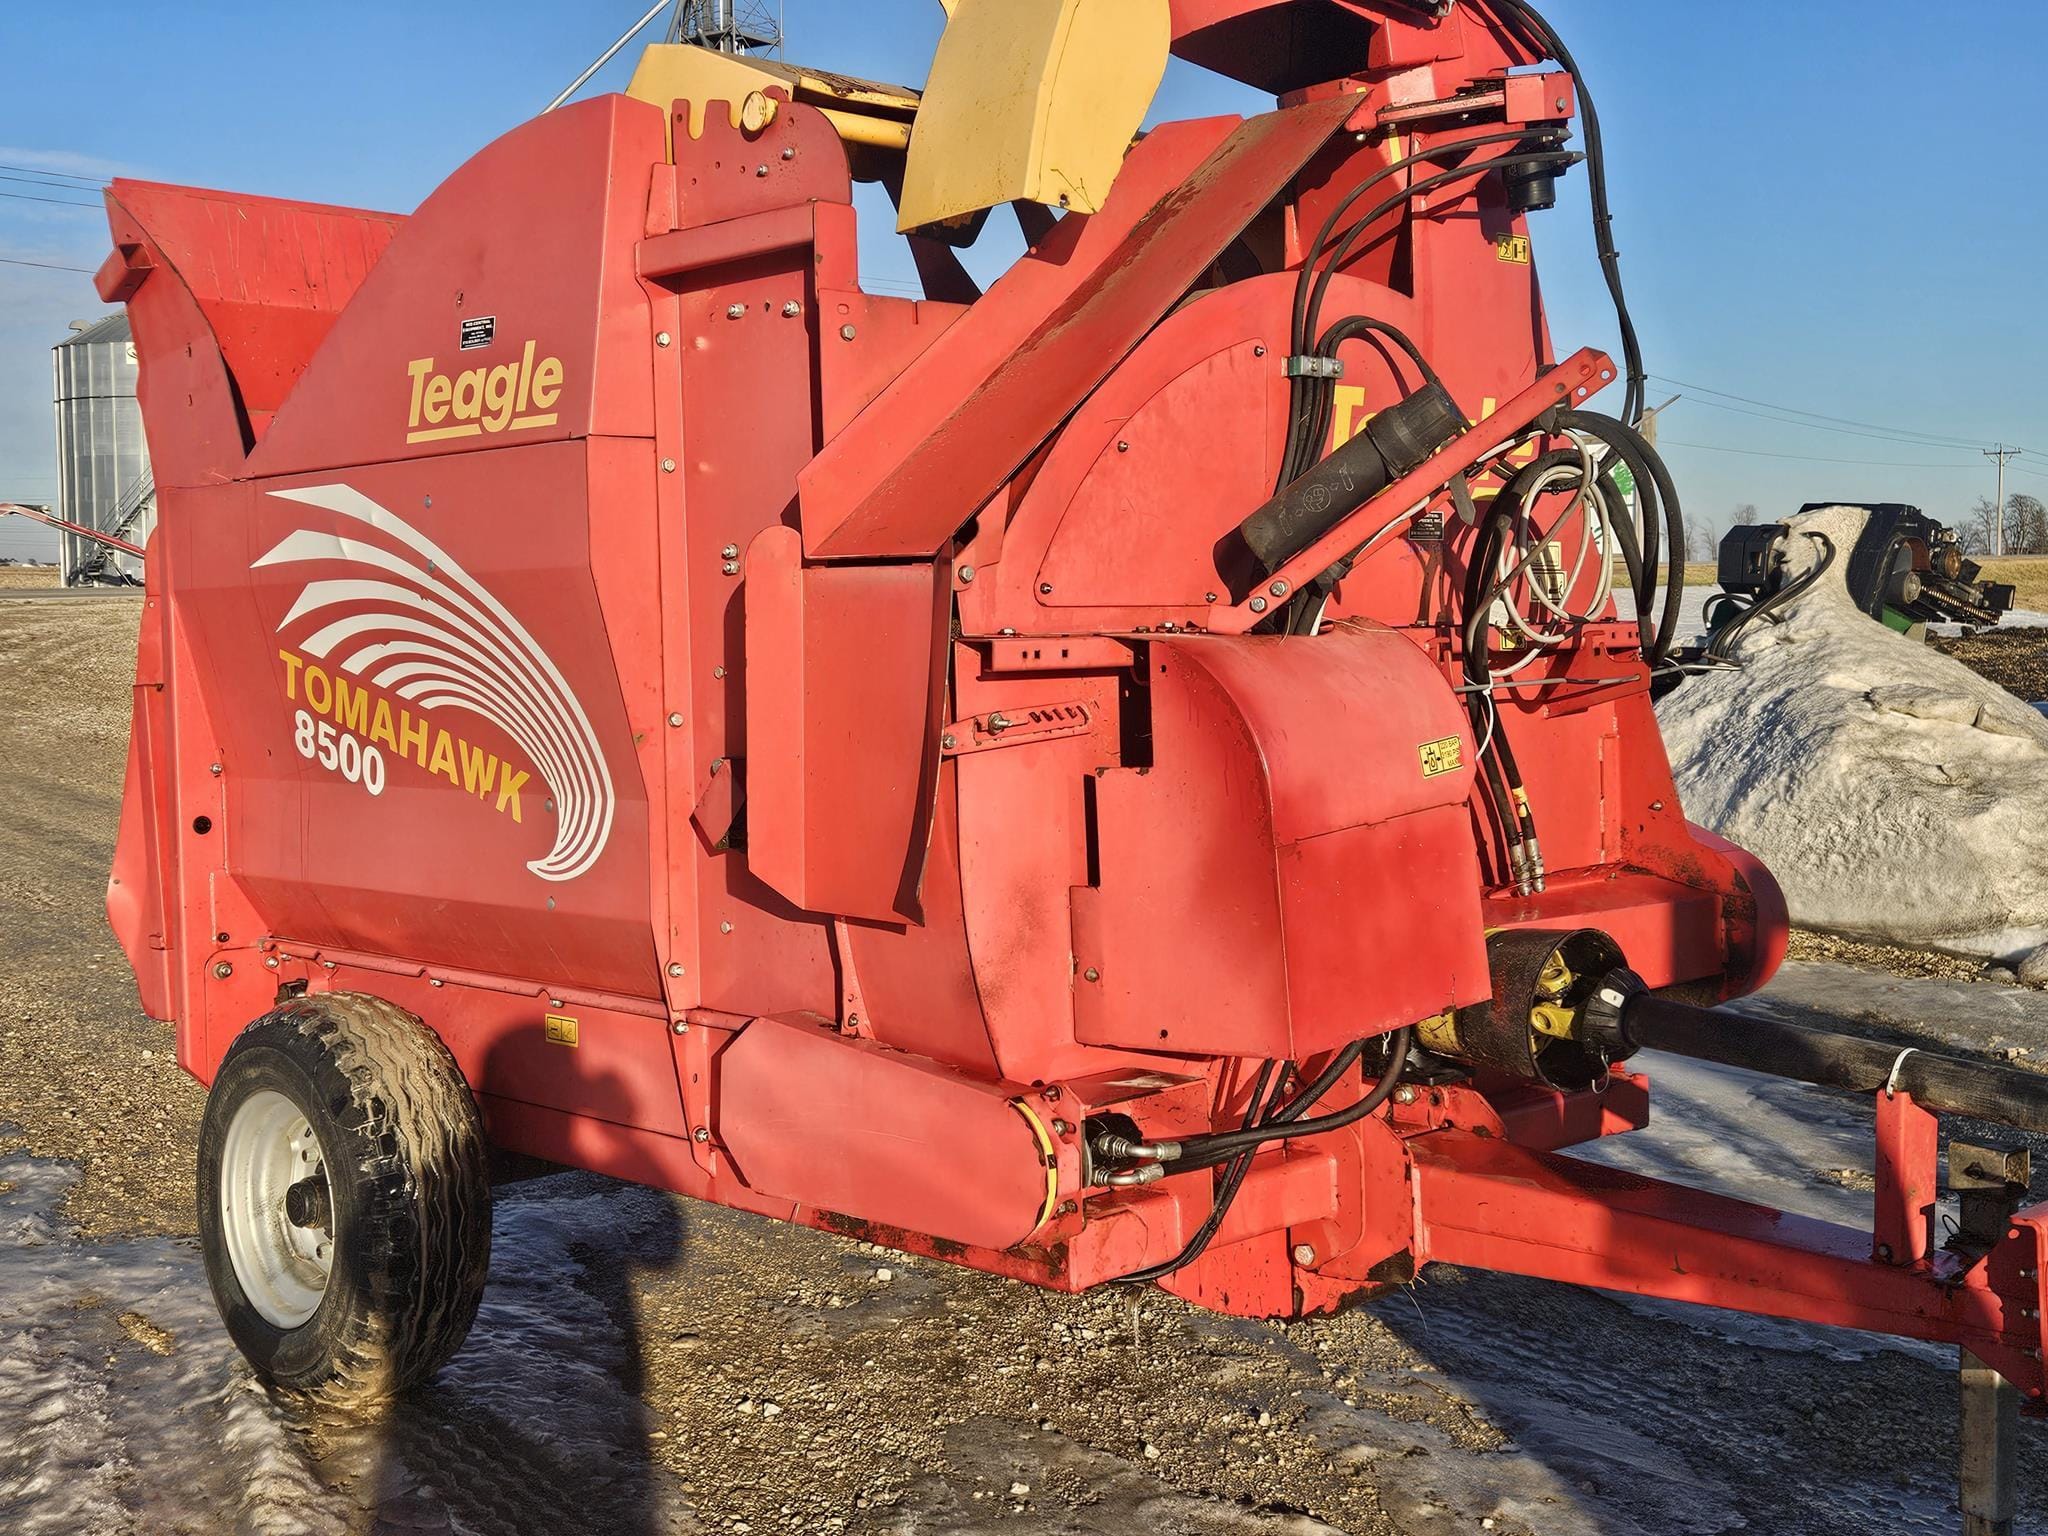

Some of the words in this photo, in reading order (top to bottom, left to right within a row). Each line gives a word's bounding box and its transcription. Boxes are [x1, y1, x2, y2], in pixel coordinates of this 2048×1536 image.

[408, 340, 564, 432] Teagle
[279, 649, 530, 824] TOMAHAWK
[295, 709, 385, 796] 8500
